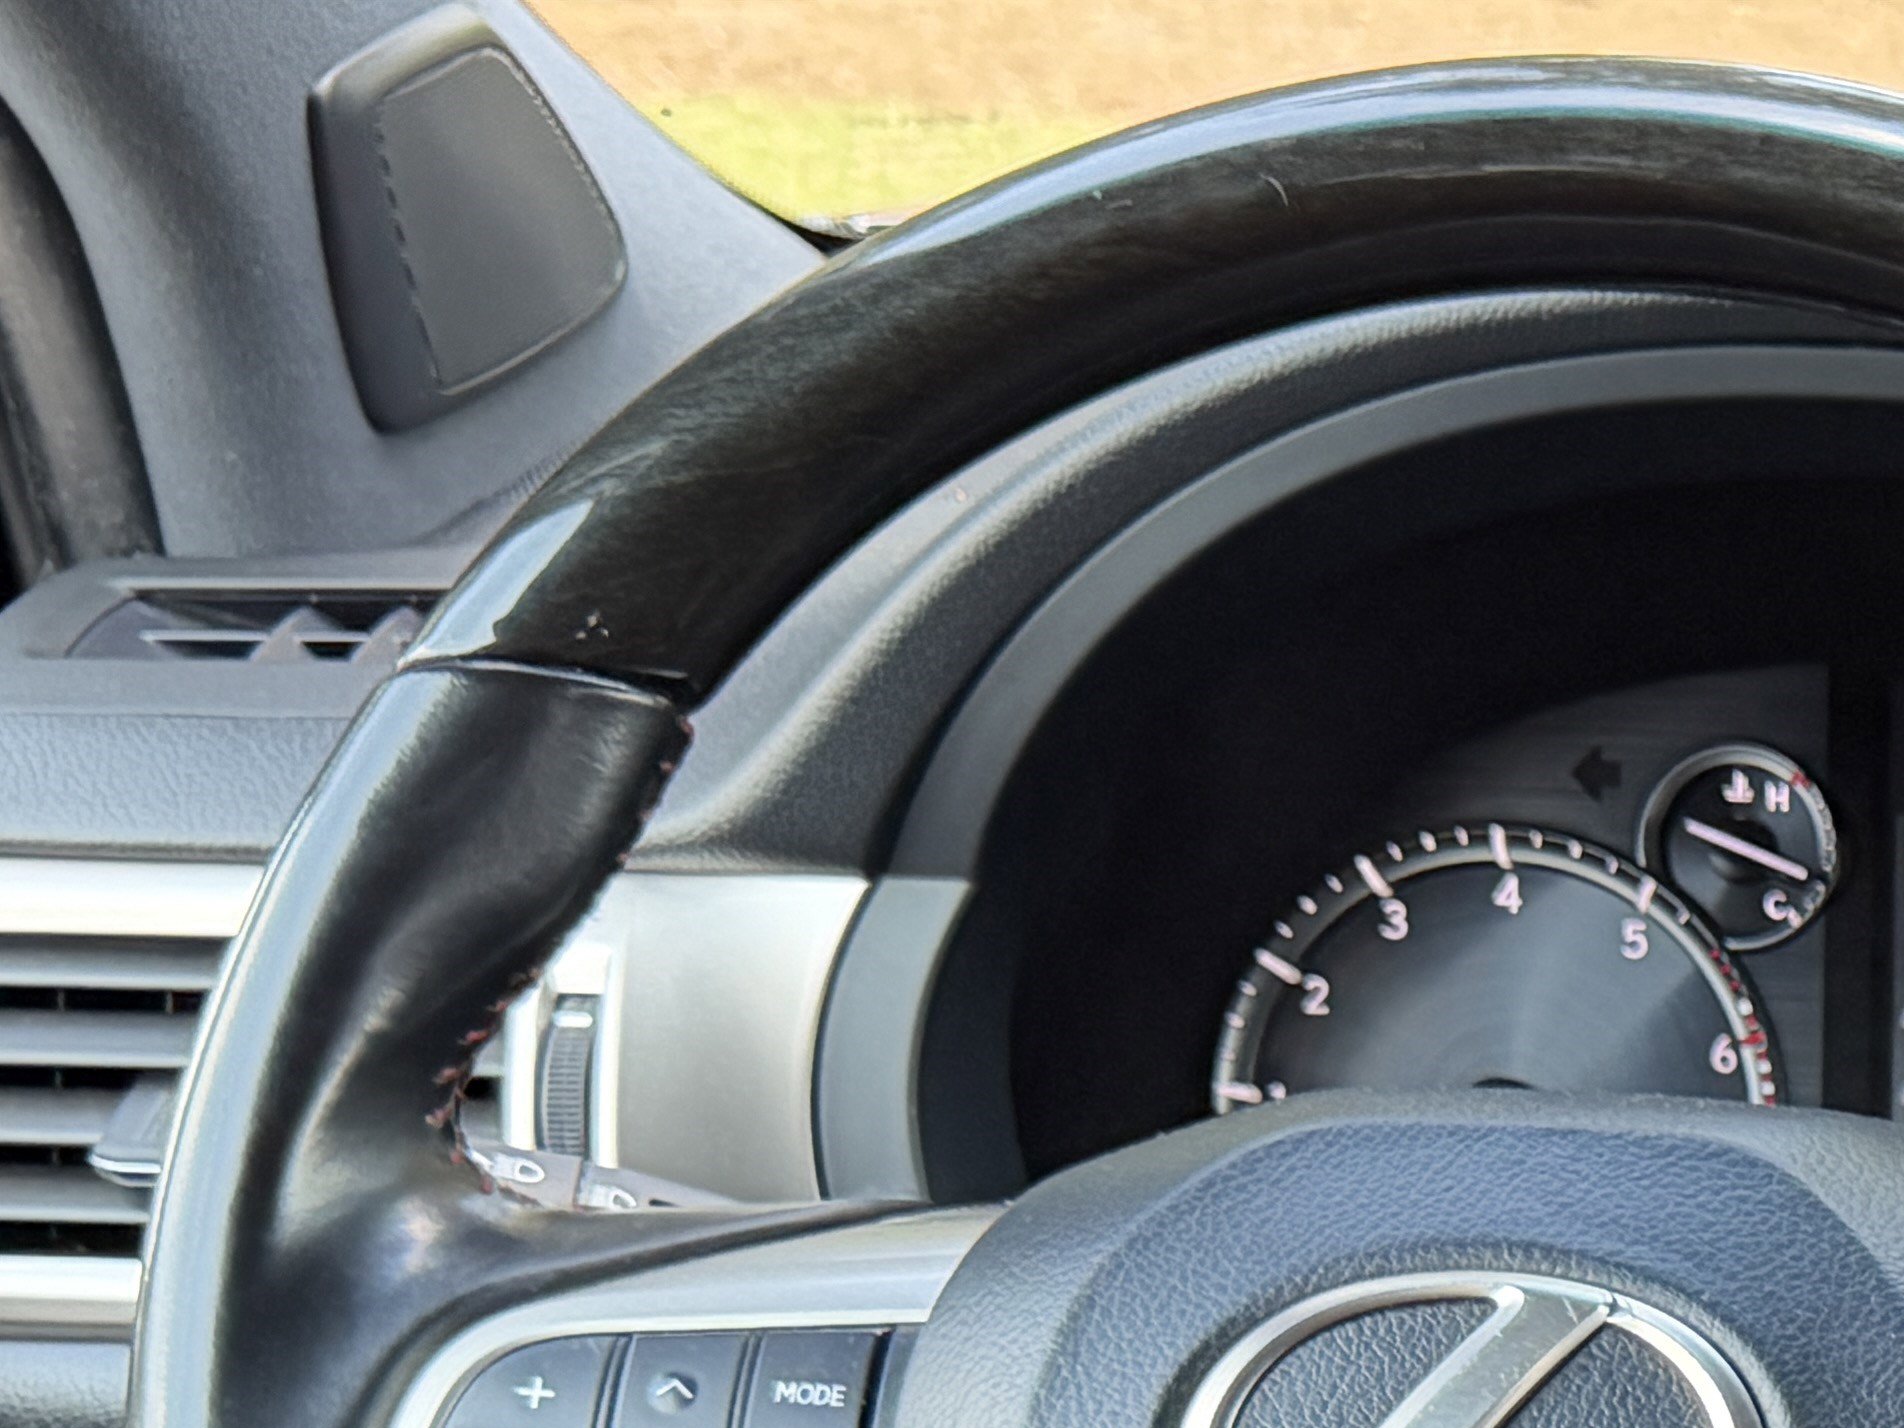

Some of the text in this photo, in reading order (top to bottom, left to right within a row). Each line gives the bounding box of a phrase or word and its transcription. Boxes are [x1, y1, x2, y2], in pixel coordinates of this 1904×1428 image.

[1764, 780, 1790, 812] H
[1491, 873, 1524, 915] 4
[1762, 889, 1788, 921] C
[1377, 901, 1409, 941] 3
[1620, 919, 1650, 961] 5
[1301, 974, 1331, 1016] 2
[1709, 1034, 1740, 1074] 6
[773, 1381, 846, 1408] MODE
